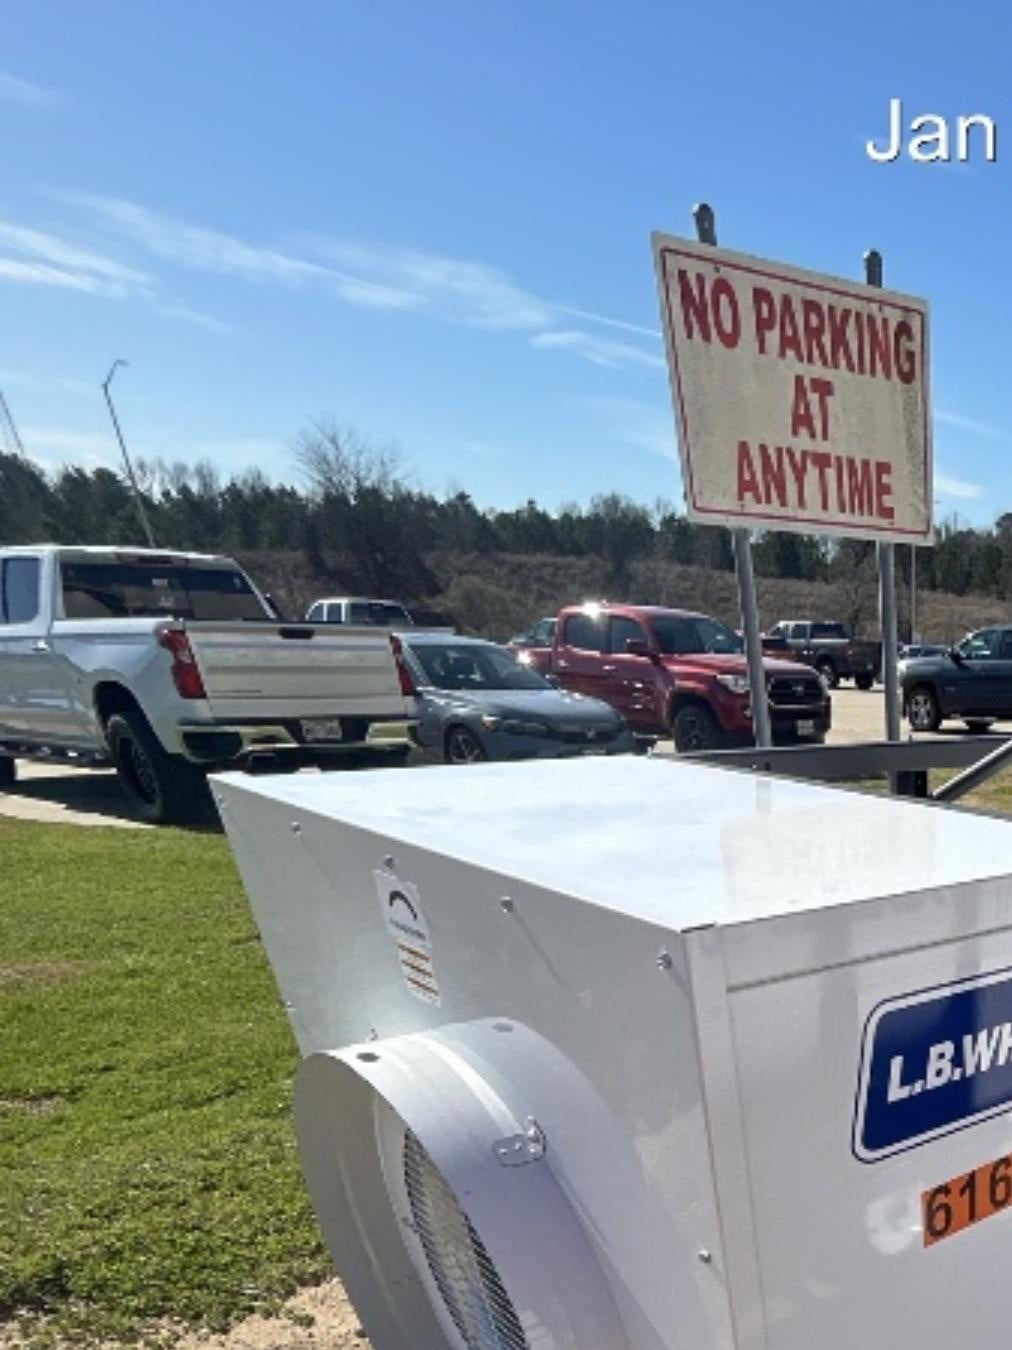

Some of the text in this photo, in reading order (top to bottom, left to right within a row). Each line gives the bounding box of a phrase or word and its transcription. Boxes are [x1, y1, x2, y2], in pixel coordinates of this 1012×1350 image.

[677, 269, 916, 385] NO PARKING
[791, 374, 834, 441] AT
[736, 440, 895, 519] ANYTIME
